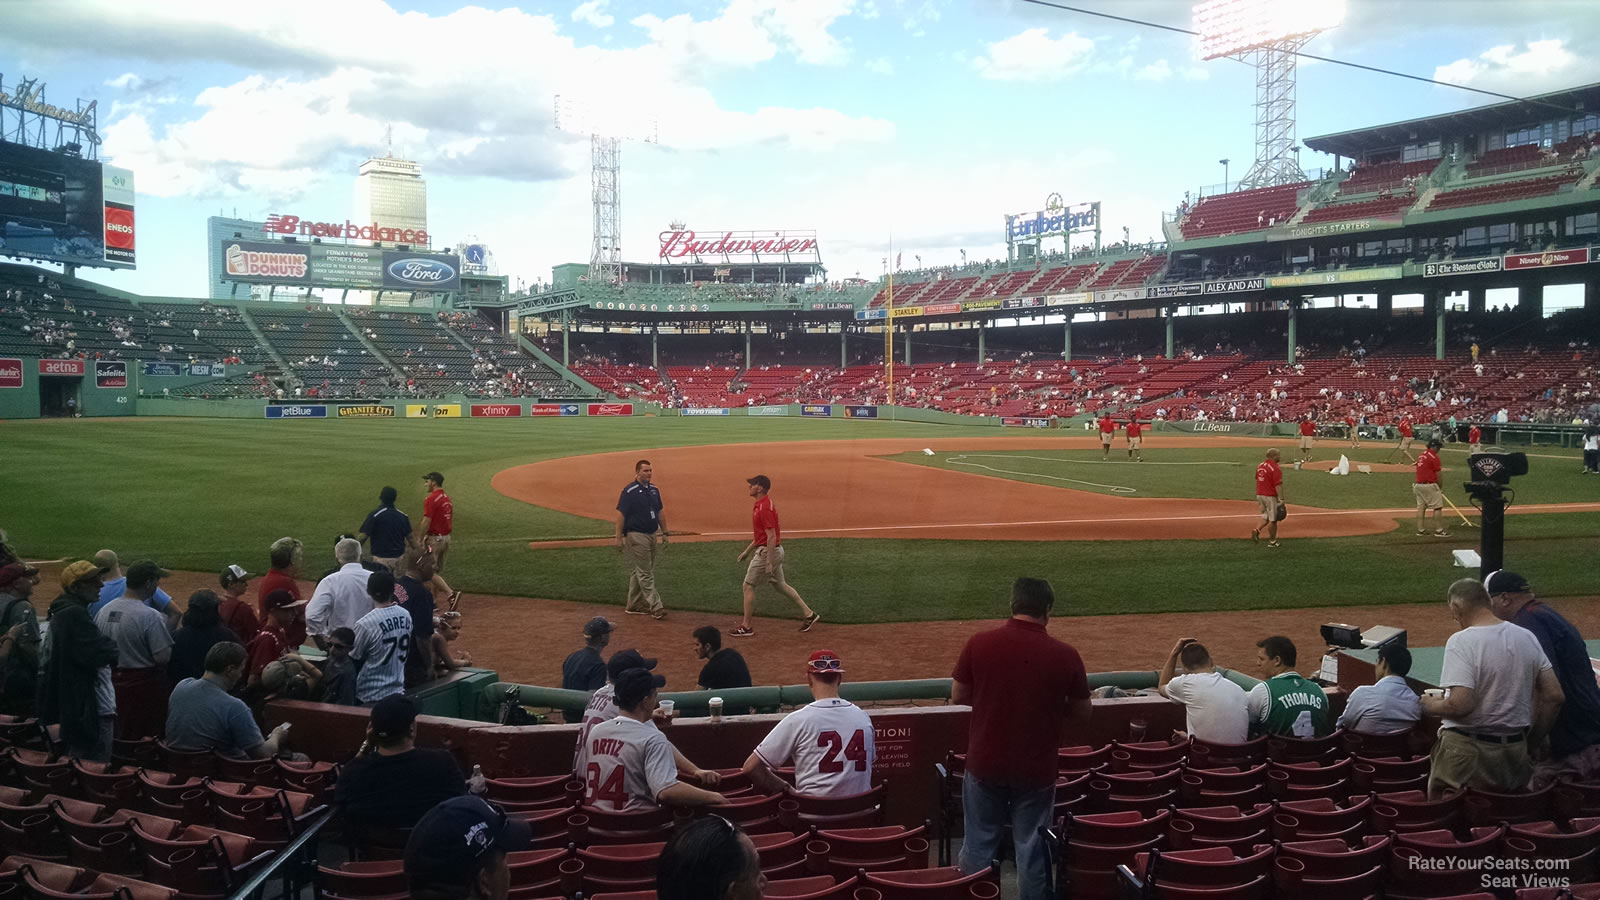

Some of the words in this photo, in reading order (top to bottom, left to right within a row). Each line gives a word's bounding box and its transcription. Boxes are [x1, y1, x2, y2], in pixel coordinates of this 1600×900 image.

[1009, 203, 1097, 237] Cumberland
[107, 223, 133, 234] ENEOS
[300, 220, 343, 238] new
[346, 219, 428, 244] balance
[1291, 226, 1328, 237] TONIGHT'S
[1330, 221, 1370, 232] STARTERS
[659, 230, 816, 258] Budweiser
[250, 253, 306, 265] DUNKIN'
[1519, 256, 1541, 265] Ninety
[1553, 254, 1569, 262] Nine
[250, 264, 304, 276] DONUTS
[401, 262, 442, 281] Ford
[1426, 265, 1436, 275] B
[1438, 264, 1451, 273] The
[1452, 263, 1476, 272] Boston
[1476, 260, 1497, 270] Globe
[1326, 274, 1336, 282] VS
[1207, 282, 1226, 292] ALEX
[1228, 281, 1246, 291] AND
[1247, 280, 1262, 289] ANI
[827, 302, 853, 310] L.L.Bean
[46, 362, 78, 373] aetna
[97, 369, 125, 377] Safelite
[191, 365, 209, 375] NESN
[281, 406, 312, 417] jetBlue
[339, 406, 375, 416] GRANITE
[376, 405, 394, 416] CITY
[420, 407, 448, 416] Non
[482, 406, 511, 416] xfinity
[1193, 423, 1231, 432] L.L.Bean
[382, 633, 410, 666] 79
[1278, 692, 1322, 710] THOMAS
[1291, 710, 1315, 740] 4
[874, 727, 911, 738] TION!
[592, 738, 625, 758] ORTIZ
[817, 729, 867, 773] 24
[584, 762, 629, 810] 34
